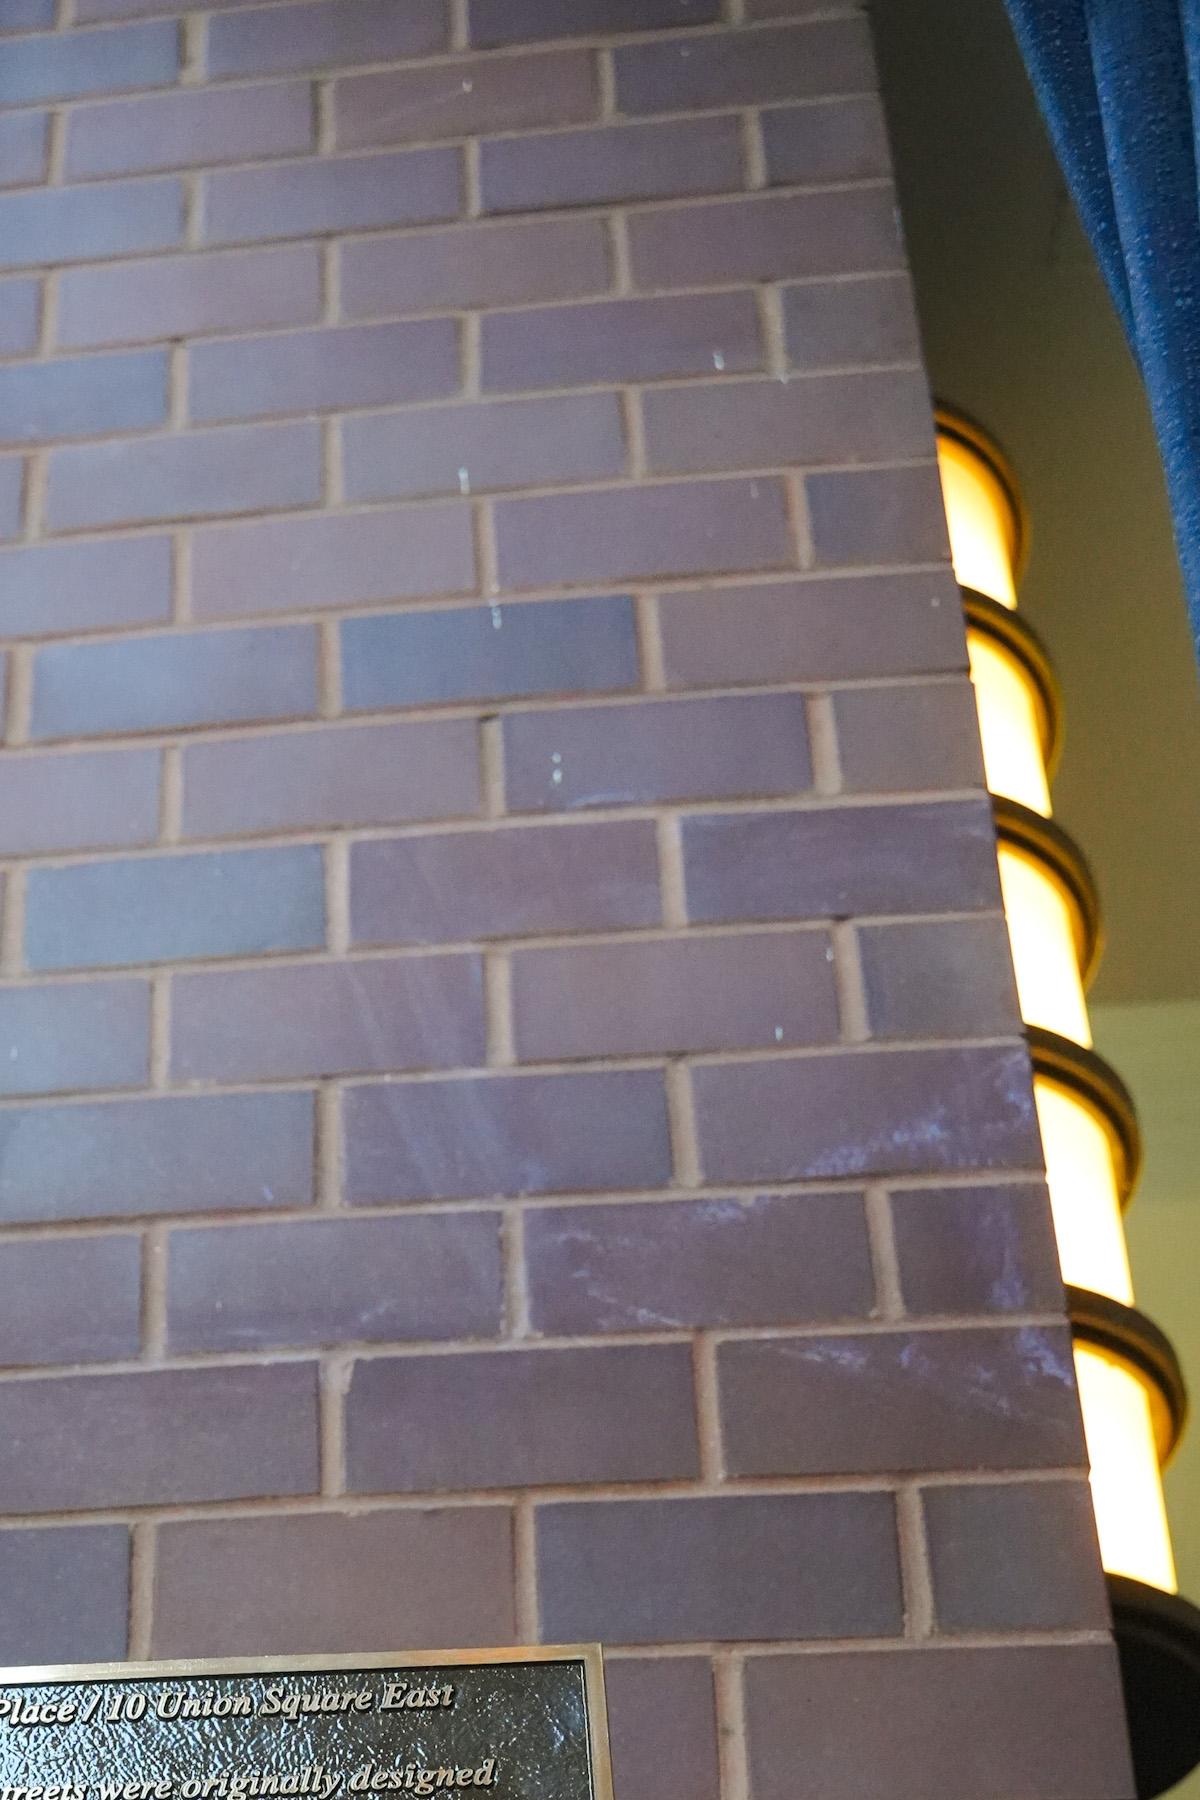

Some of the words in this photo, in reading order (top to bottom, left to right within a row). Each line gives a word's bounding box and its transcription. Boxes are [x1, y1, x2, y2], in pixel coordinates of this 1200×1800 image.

[82, 1694, 99, 1723] /
[107, 1693, 146, 1721] 10
[157, 1692, 252, 1719] Union
[260, 1688, 371, 1721] Square
[381, 1682, 454, 1709] East
[97, 1775, 171, 1800] were
[349, 1760, 495, 1795] designed
